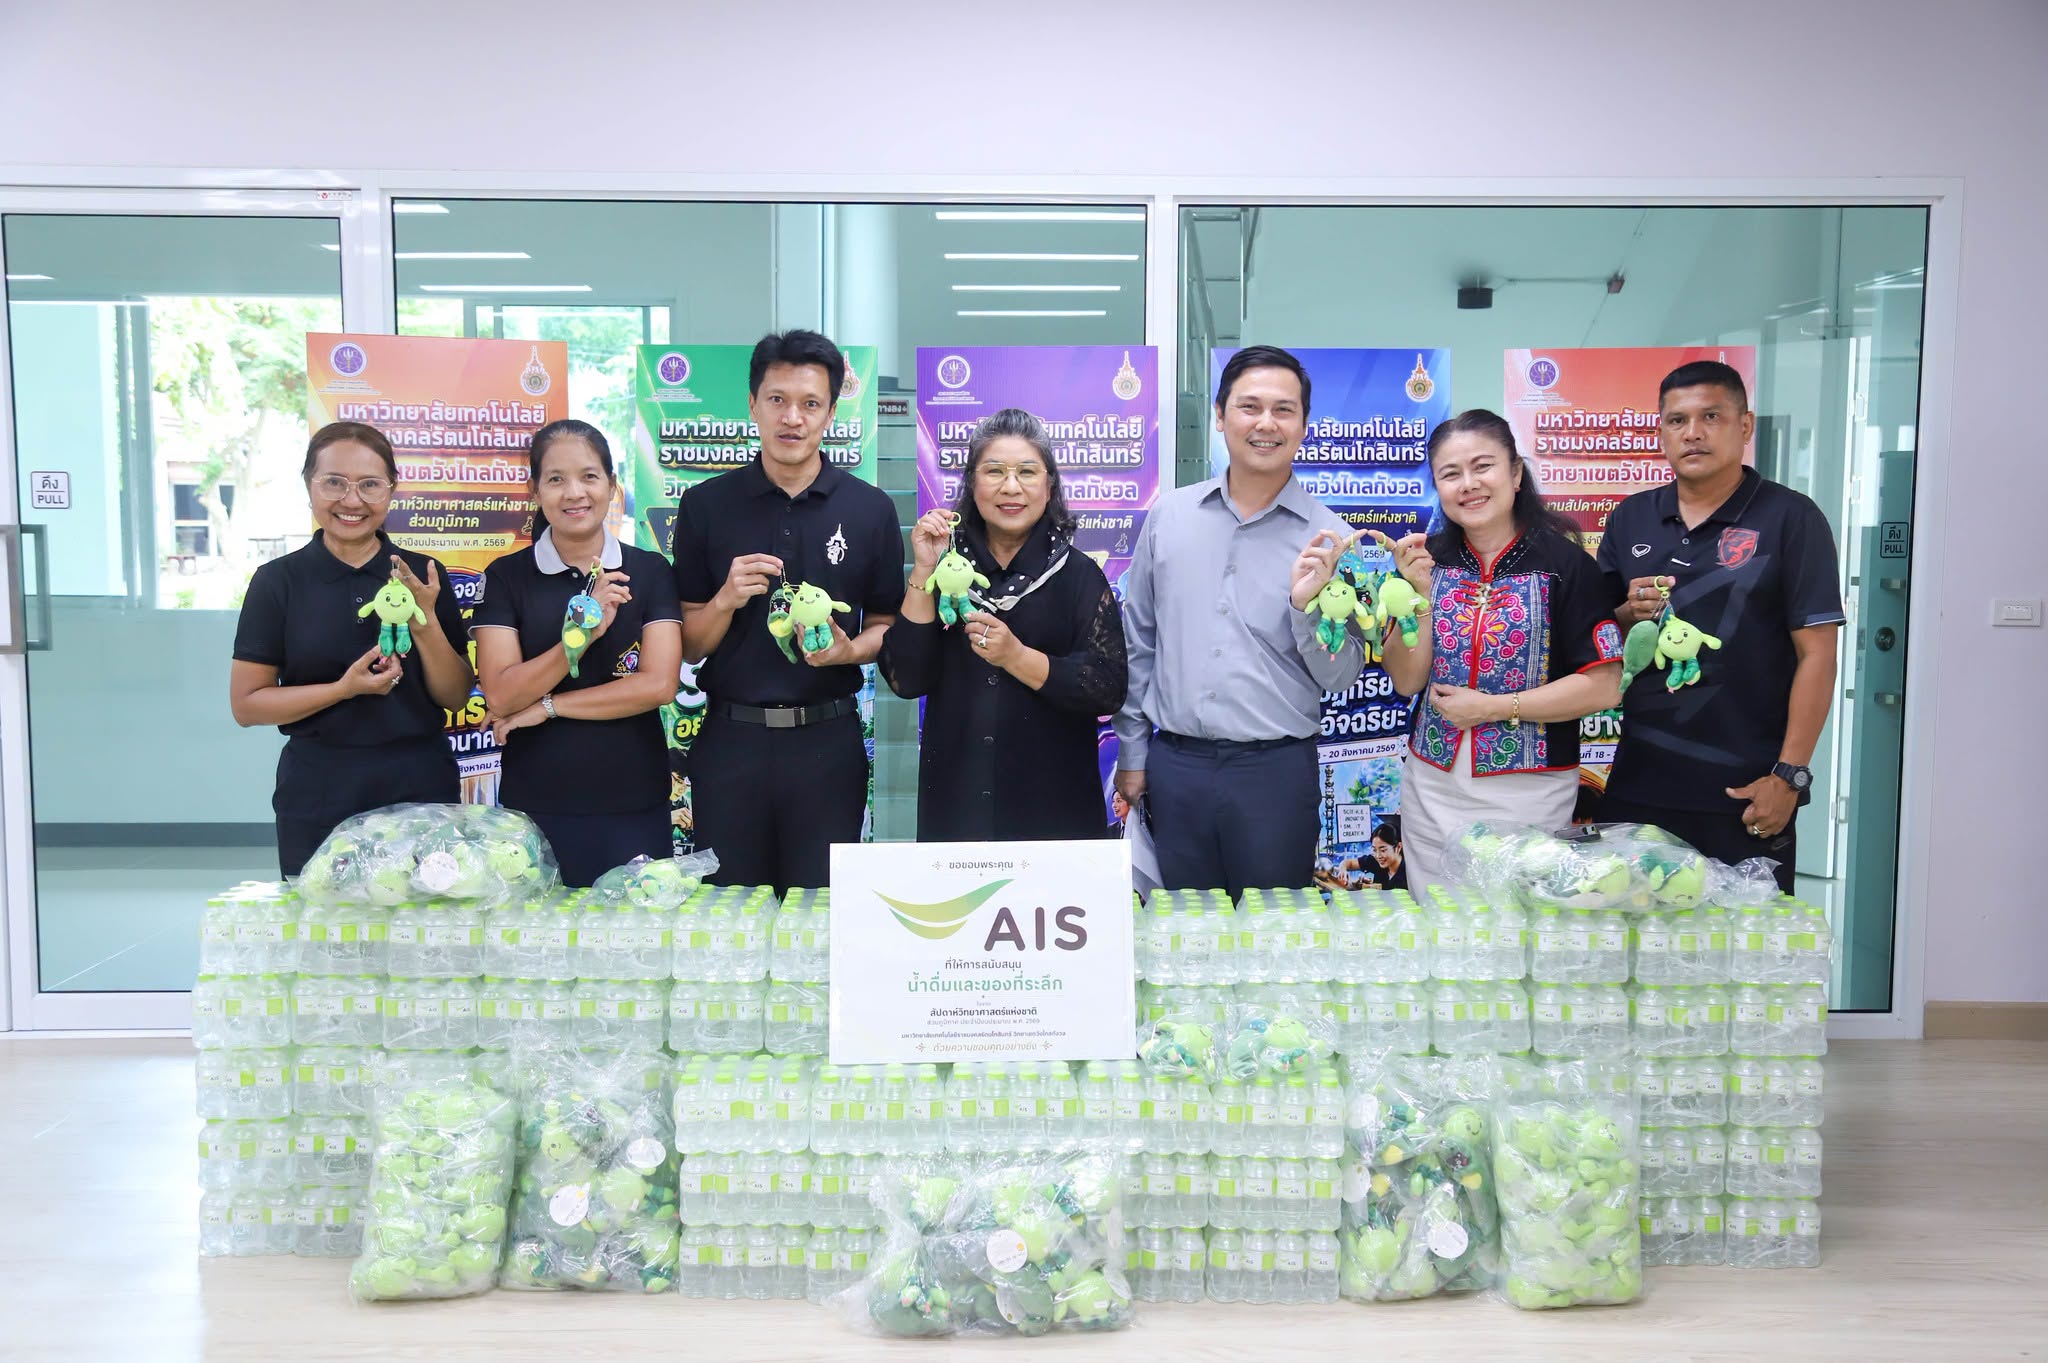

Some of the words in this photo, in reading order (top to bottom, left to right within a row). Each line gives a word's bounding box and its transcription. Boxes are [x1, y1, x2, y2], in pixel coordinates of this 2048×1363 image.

[338, 401, 545, 423] มหาวิทยาลัยเทคโนโลยี
[1537, 431, 1658, 450] ราชมงคลรัตน
[1294, 440, 1425, 461] คลรัตนโกสินทร์
[1541, 461, 1676, 482] วิทยาเขตวังไกล
[42, 474, 58, 489] ดึง
[1300, 472, 1421, 495] ตวังไกลกังวล
[37, 494, 64, 504] PULL
[408, 512, 480, 532] ส่วนภูมิภาค
[1888, 526, 1901, 539] ดึง
[392, 536, 460, 548] ะจำปีงบประมาณ
[463, 538, 482, 547] พ.ศ.
[483, 538, 506, 547] 2569
[1884, 544, 1904, 553] PULL
[1329, 750, 1340, 758] 20
[1376, 744, 1396, 753] 2569
[1595, 751, 1607, 759] 18
[949, 859, 1014, 873] ขอขอบพระคุณ
[983, 906, 1088, 952] AIS
[945, 957, 1022, 972] ที่ให้การสนับสนุน
[907, 970, 1063, 993] น้ำดื่มและของที่ระลึก
[929, 1006, 1038, 1017] สัปดาห์วิทยาศาสตร์แห่งชาติ
